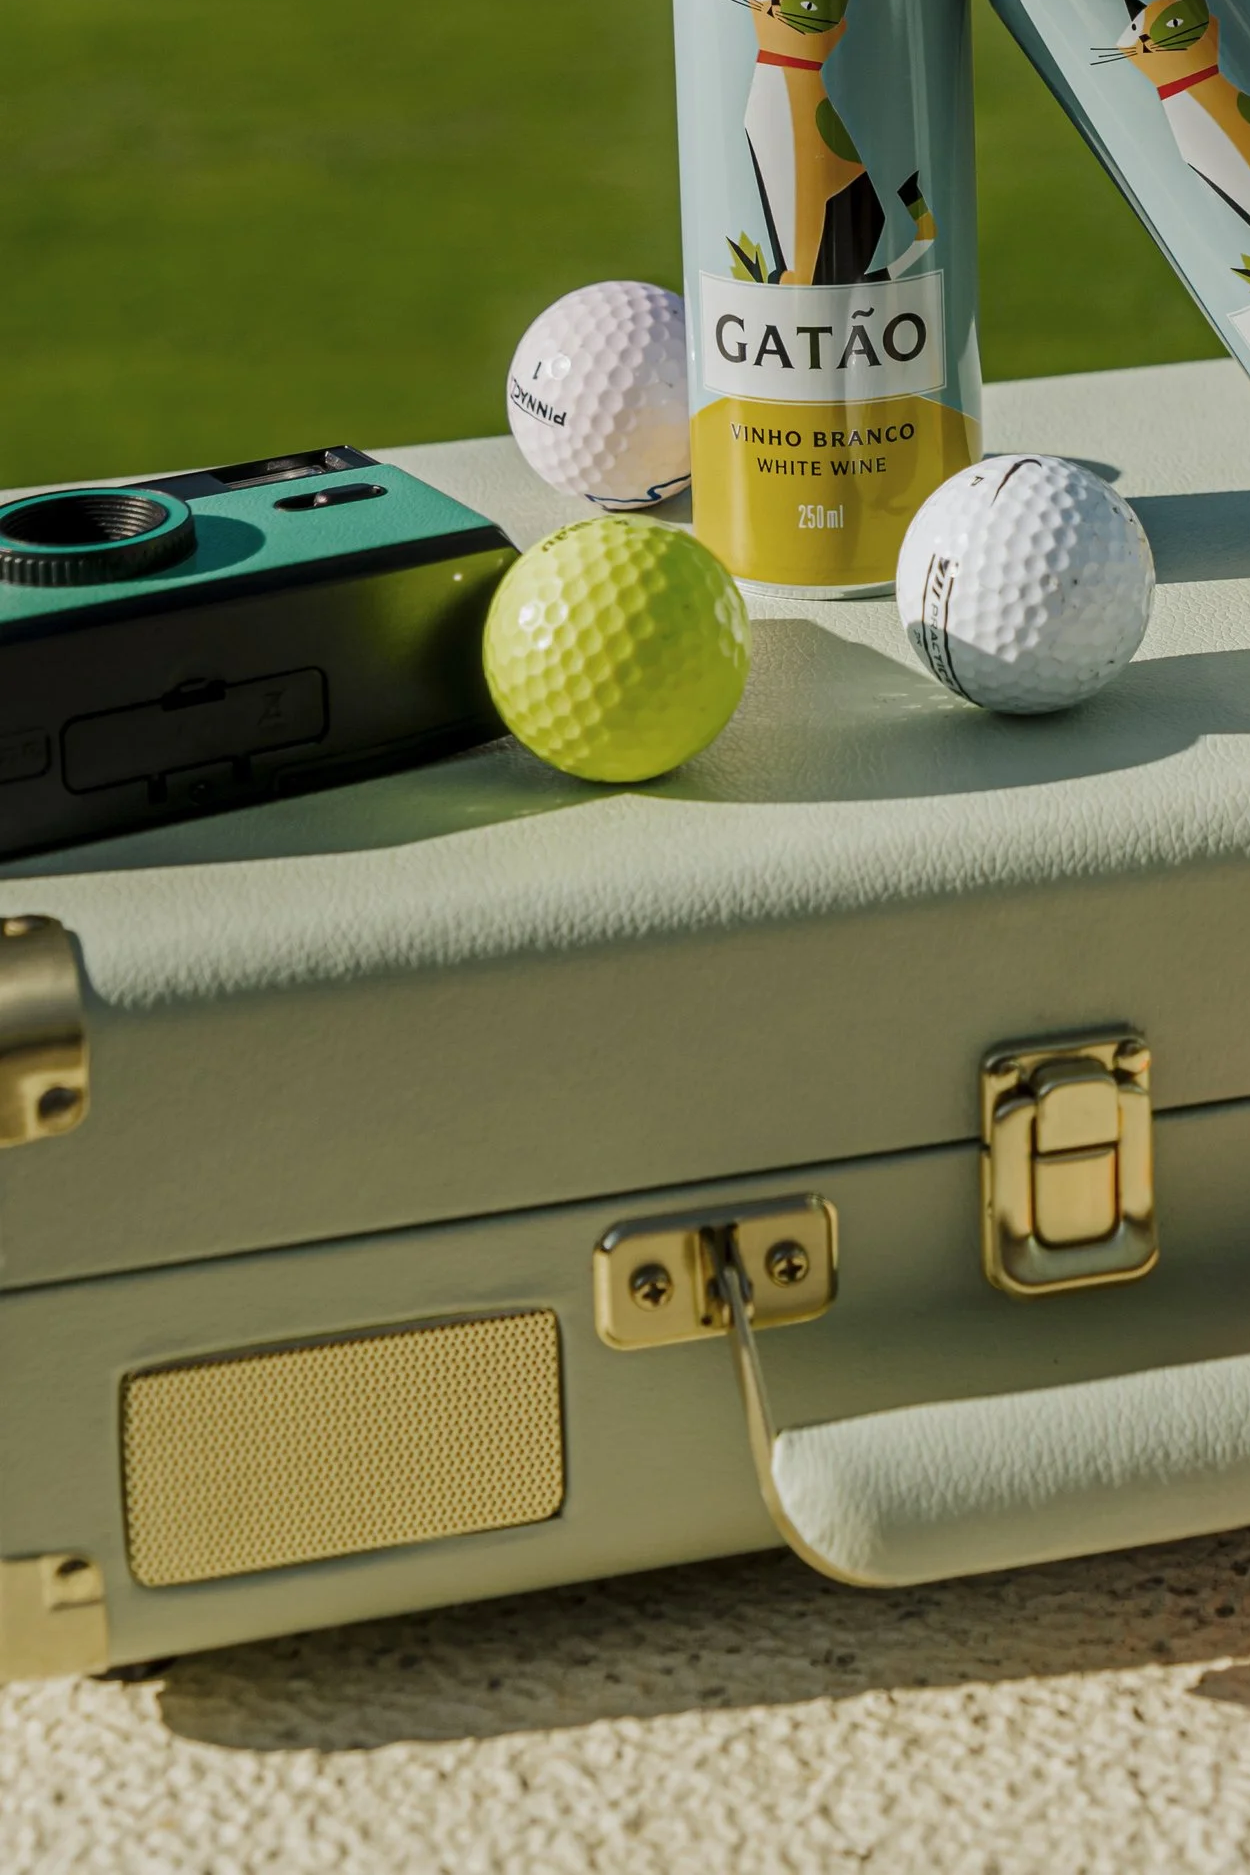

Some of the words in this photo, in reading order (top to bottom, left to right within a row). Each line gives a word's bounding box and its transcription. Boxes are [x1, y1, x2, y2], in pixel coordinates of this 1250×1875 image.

[715, 307, 927, 370] GATÃO
[510, 375, 567, 427] PINNAC
[731, 422, 802, 446] VINHO
[813, 423, 915, 447] BRANCO
[757, 457, 822, 476] WHITE
[831, 457, 887, 476] WINE
[798, 504, 844, 529] 250ml
